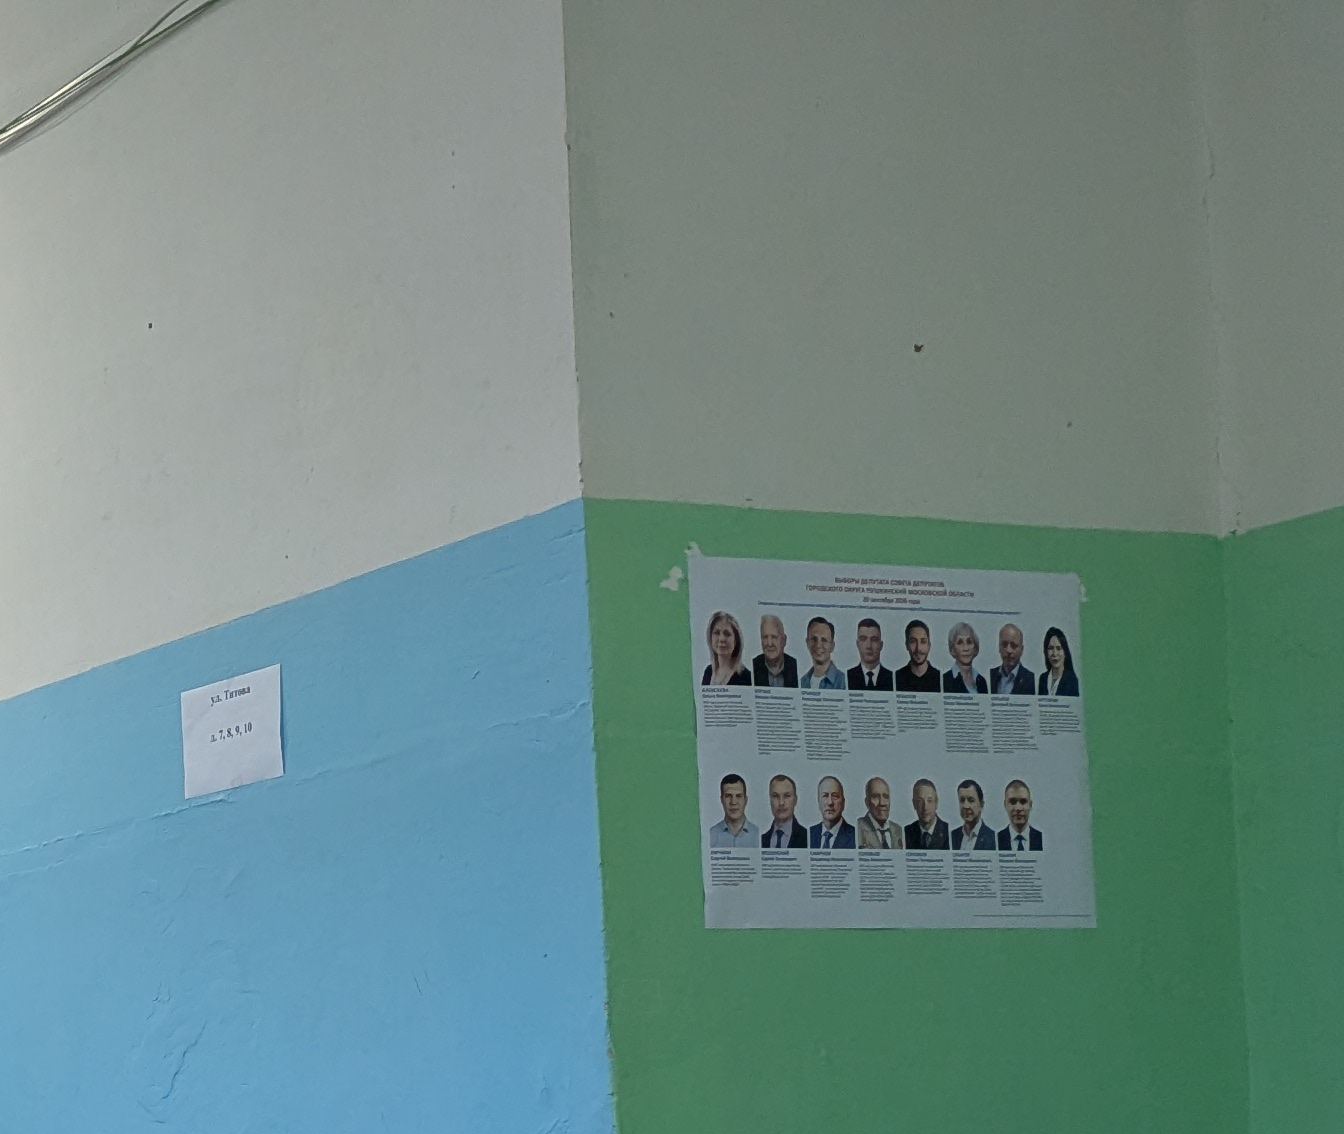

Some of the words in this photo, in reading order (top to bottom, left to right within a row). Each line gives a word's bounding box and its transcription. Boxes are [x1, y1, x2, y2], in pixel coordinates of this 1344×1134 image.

[210, 694, 222, 707] ул.
[223, 686, 251, 701] Титова
[218, 729, 226, 740] 7,
[226, 727, 233, 738] 8,
[235, 725, 242, 736] 9,
[244, 721, 253, 734] 10
